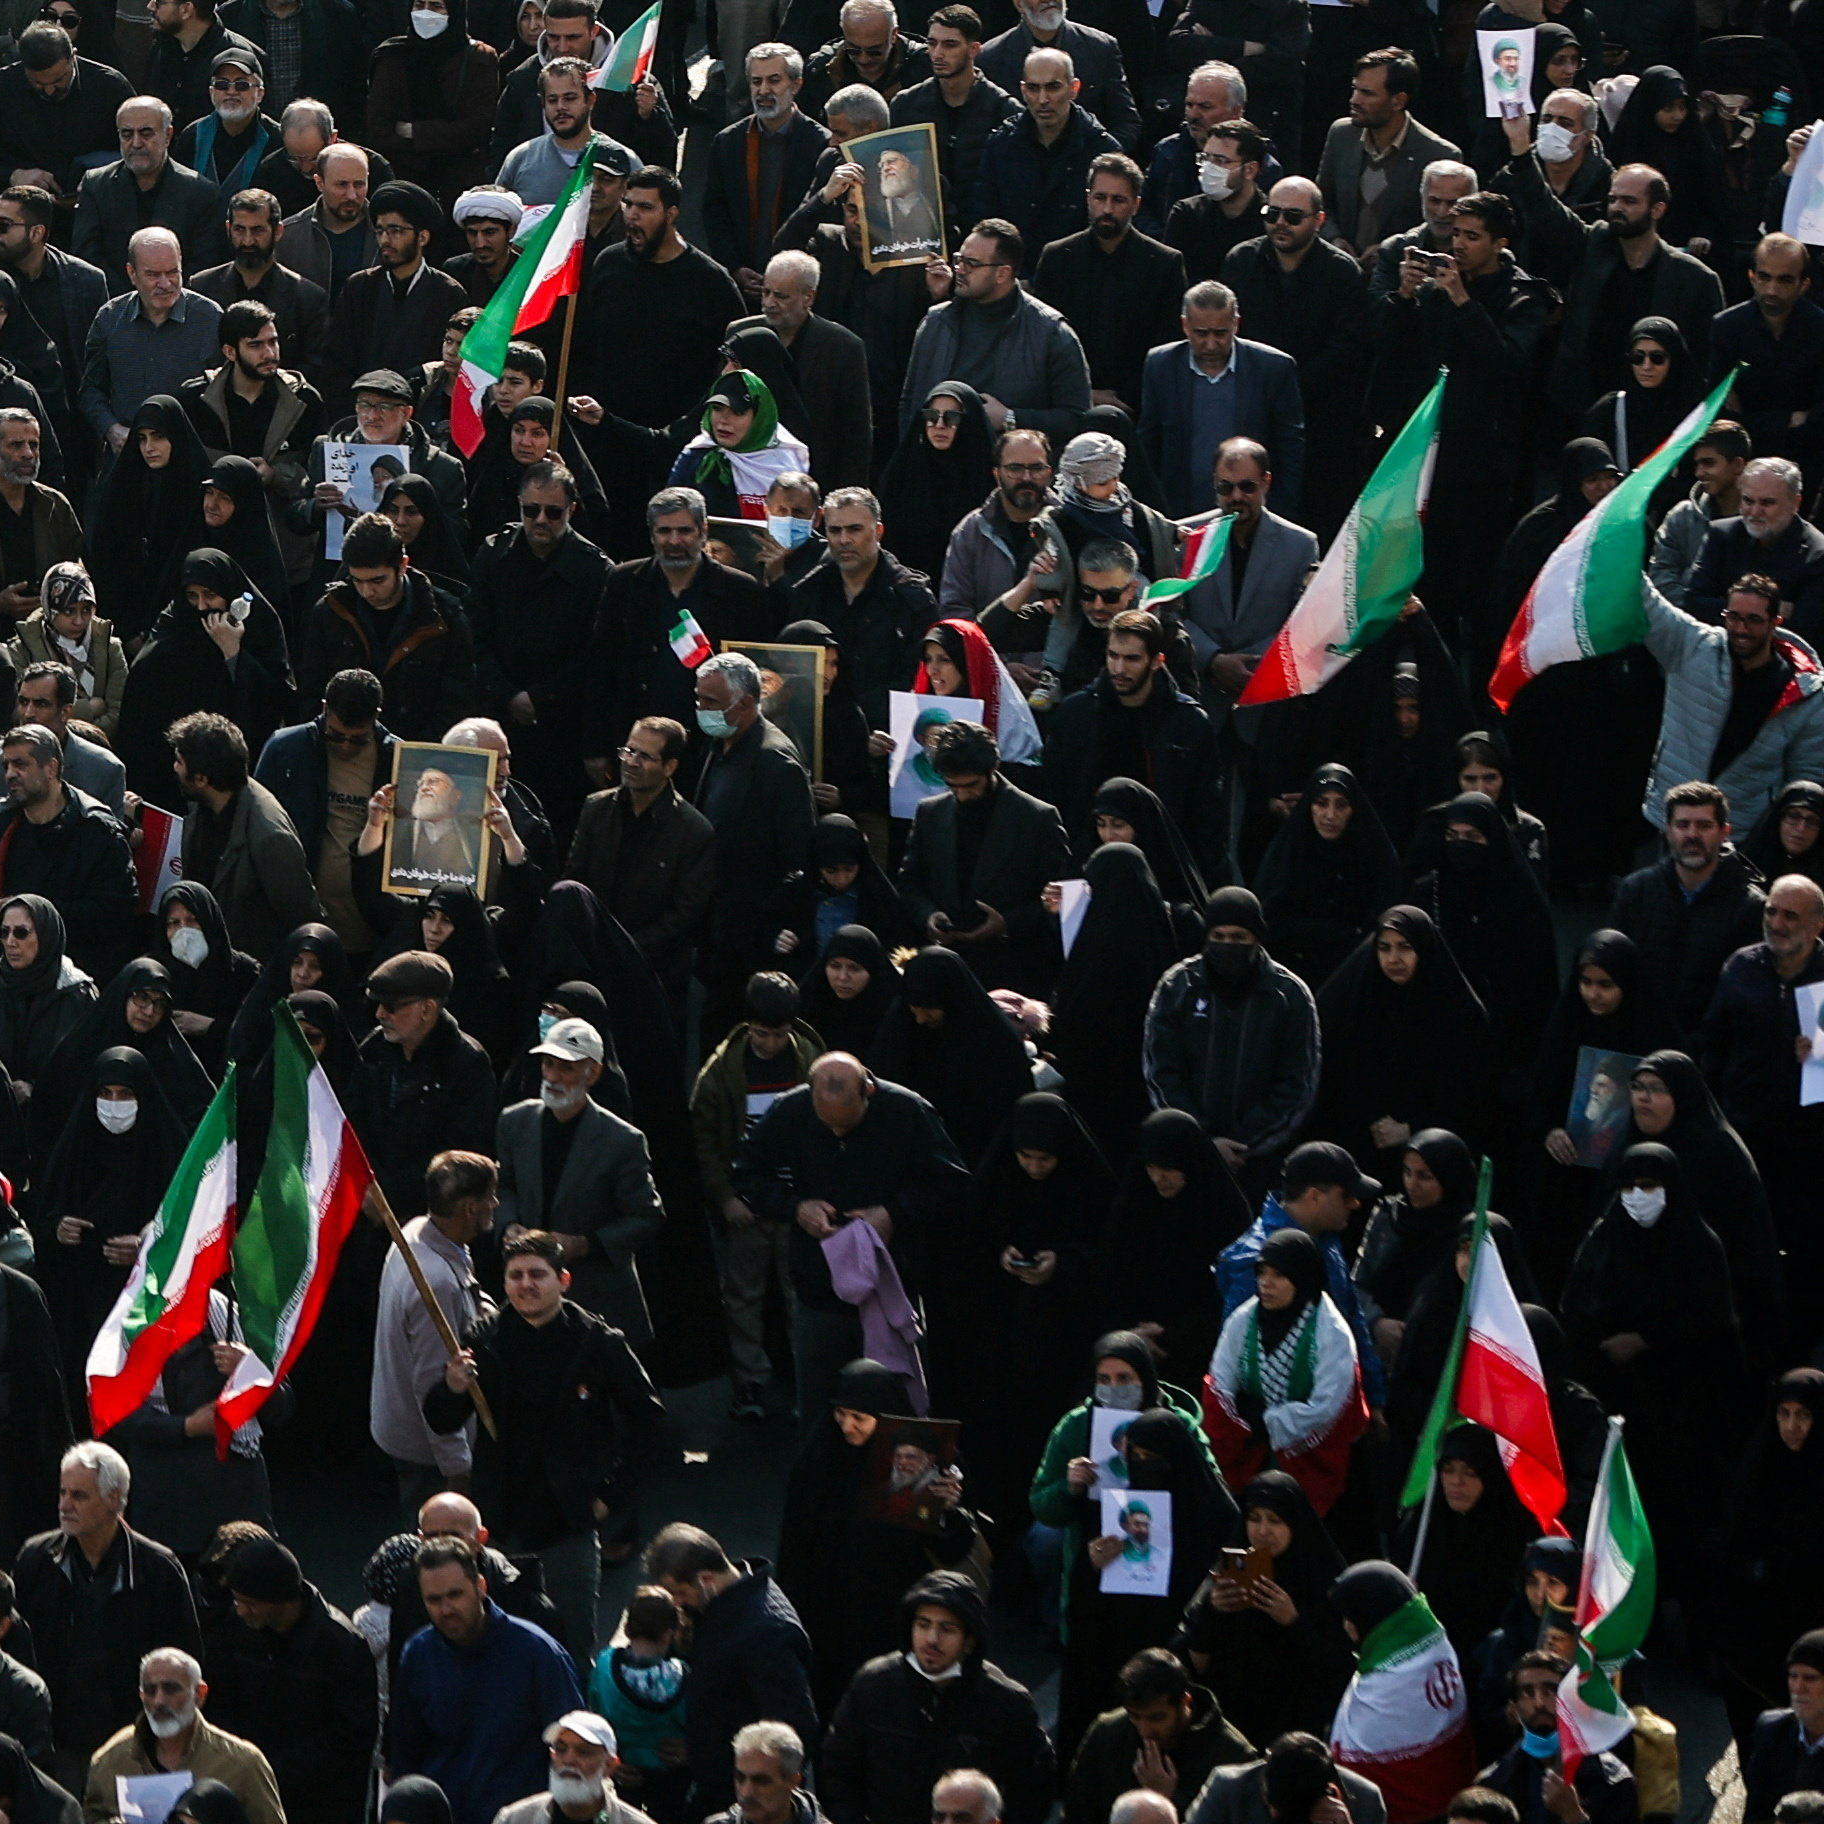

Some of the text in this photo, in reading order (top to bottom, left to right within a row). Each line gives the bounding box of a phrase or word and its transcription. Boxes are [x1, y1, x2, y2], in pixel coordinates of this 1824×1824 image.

[330, 449, 356, 460] خدای
[389, 867, 408, 878] دادی
[407, 868, 432, 881] طوفان
